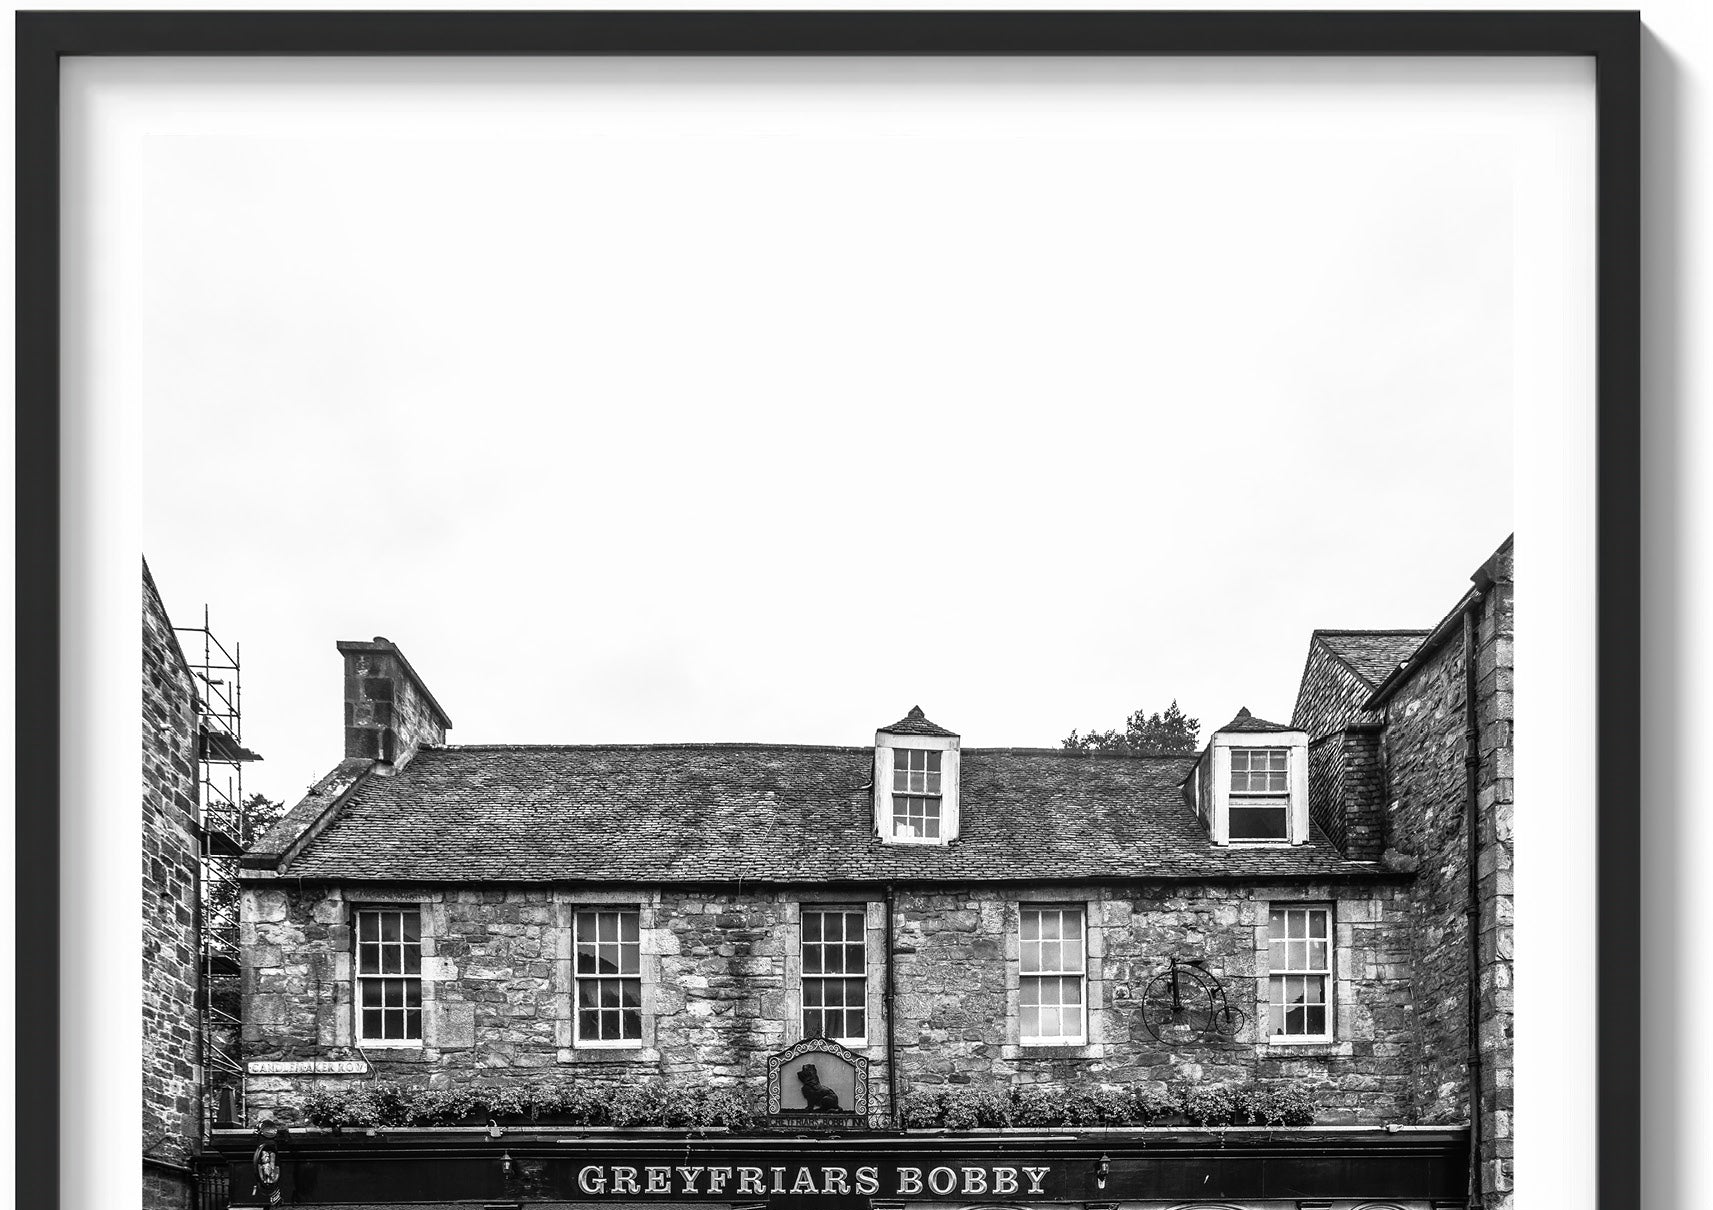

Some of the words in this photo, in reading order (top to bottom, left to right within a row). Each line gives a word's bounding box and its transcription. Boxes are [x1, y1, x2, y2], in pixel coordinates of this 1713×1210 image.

[252, 1063, 334, 1073] CANDLEMAKER
[338, 1062, 363, 1072] ROW
[577, 1165, 880, 1195] GREYFRIARS
[896, 1165, 1051, 1195] BOBBY
